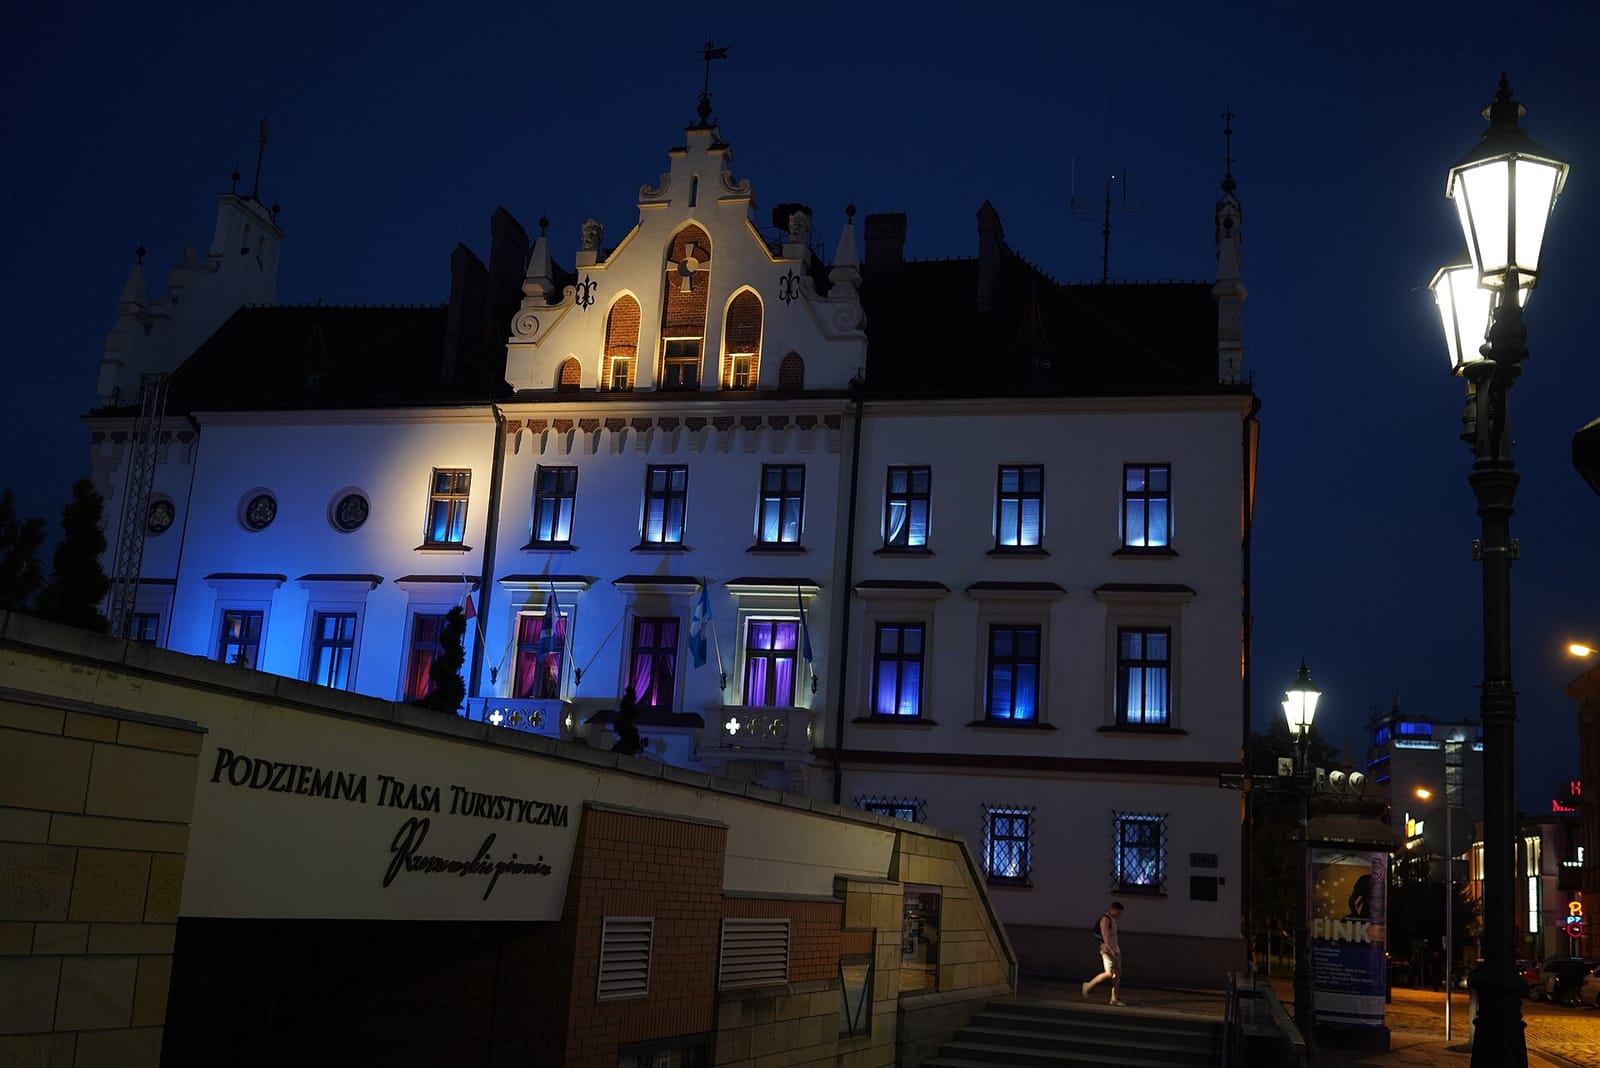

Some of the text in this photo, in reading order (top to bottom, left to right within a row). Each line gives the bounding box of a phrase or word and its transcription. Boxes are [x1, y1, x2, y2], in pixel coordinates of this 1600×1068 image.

[210, 748, 569, 828] PODZIEMNA TRASA TURYSTYCZNA
